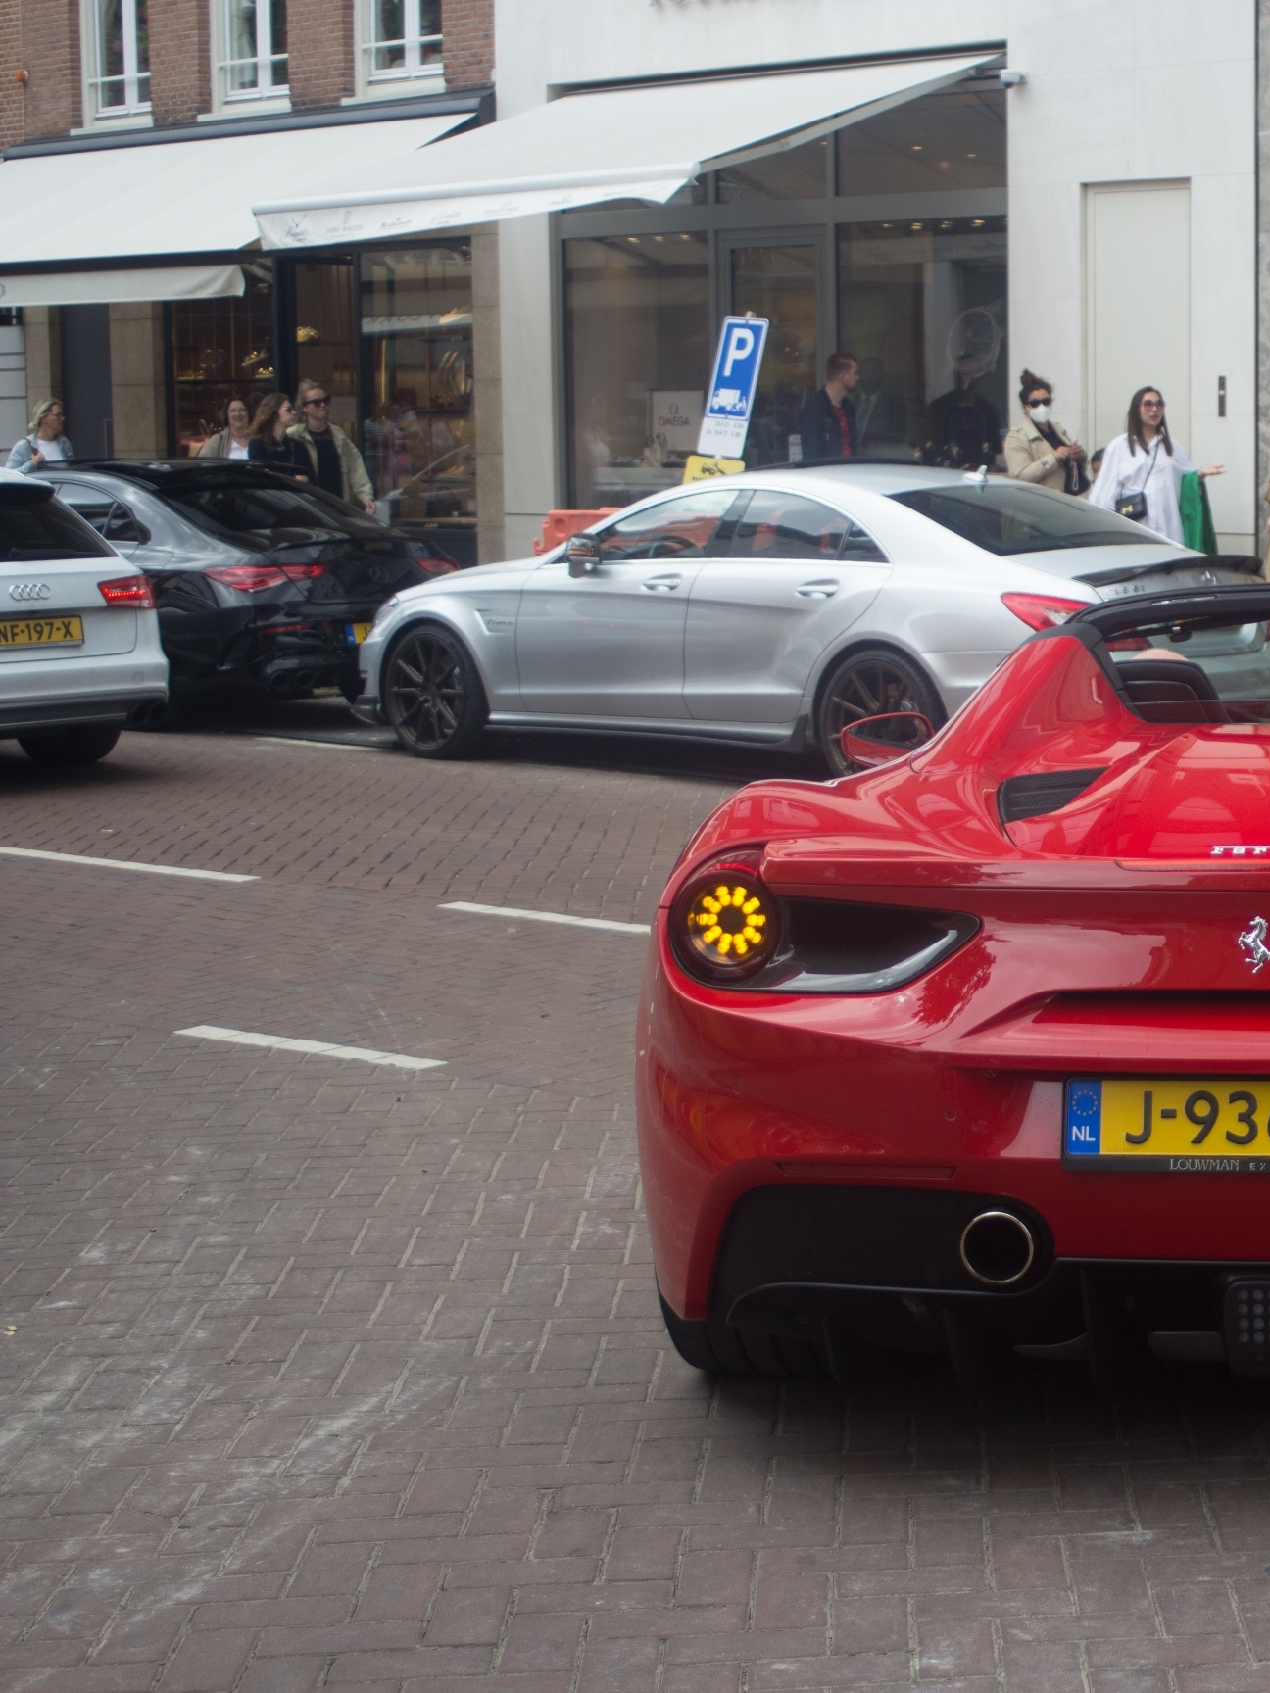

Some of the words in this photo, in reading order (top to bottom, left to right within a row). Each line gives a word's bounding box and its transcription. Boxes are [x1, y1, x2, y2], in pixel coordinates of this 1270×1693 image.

[724, 328, 755, 376] P
[658, 416, 691, 426] OMEGA
[1072, 1127, 1095, 1141] NL
[1169, 1158, 1240, 1171] LOUWMAN
